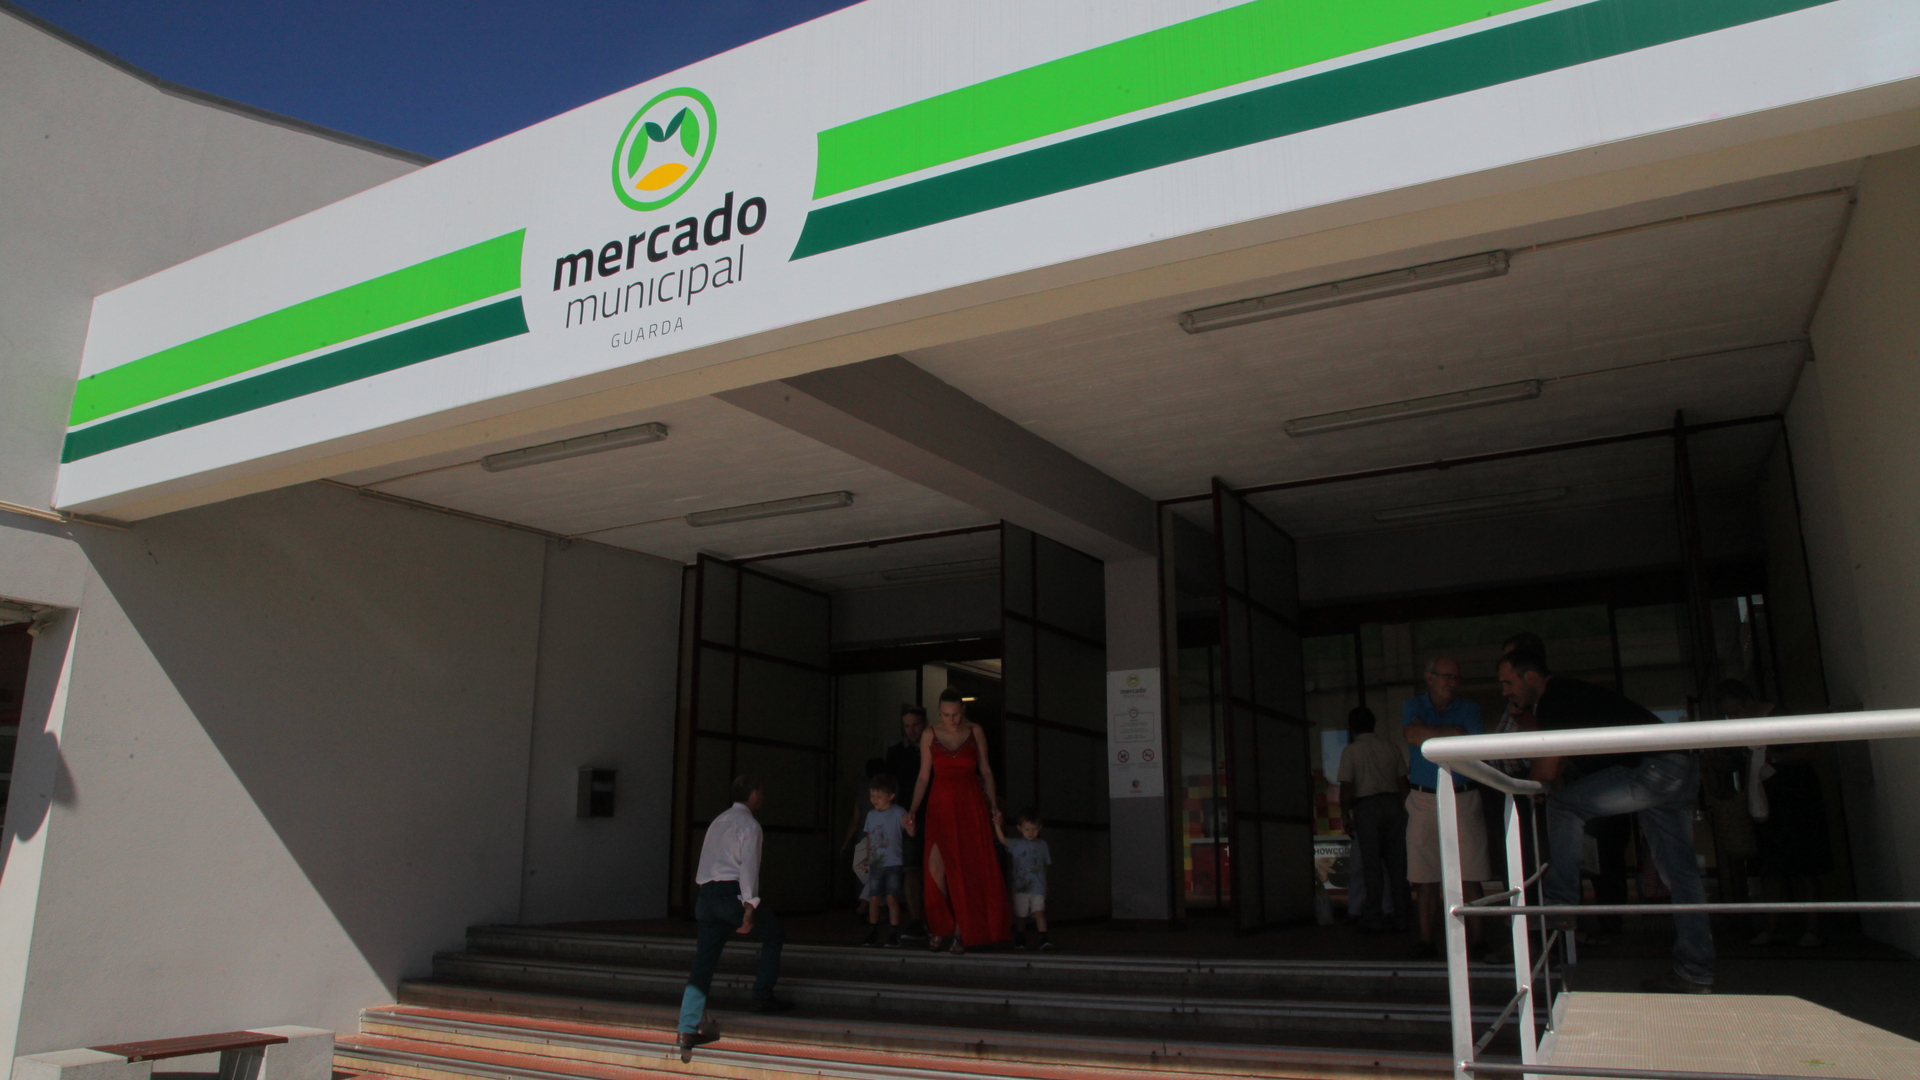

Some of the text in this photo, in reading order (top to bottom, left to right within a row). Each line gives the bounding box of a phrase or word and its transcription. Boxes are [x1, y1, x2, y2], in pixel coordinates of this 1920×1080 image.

[553, 190, 767, 291] mercado
[566, 243, 744, 328] municipal
[611, 316, 684, 348] GUARDA
